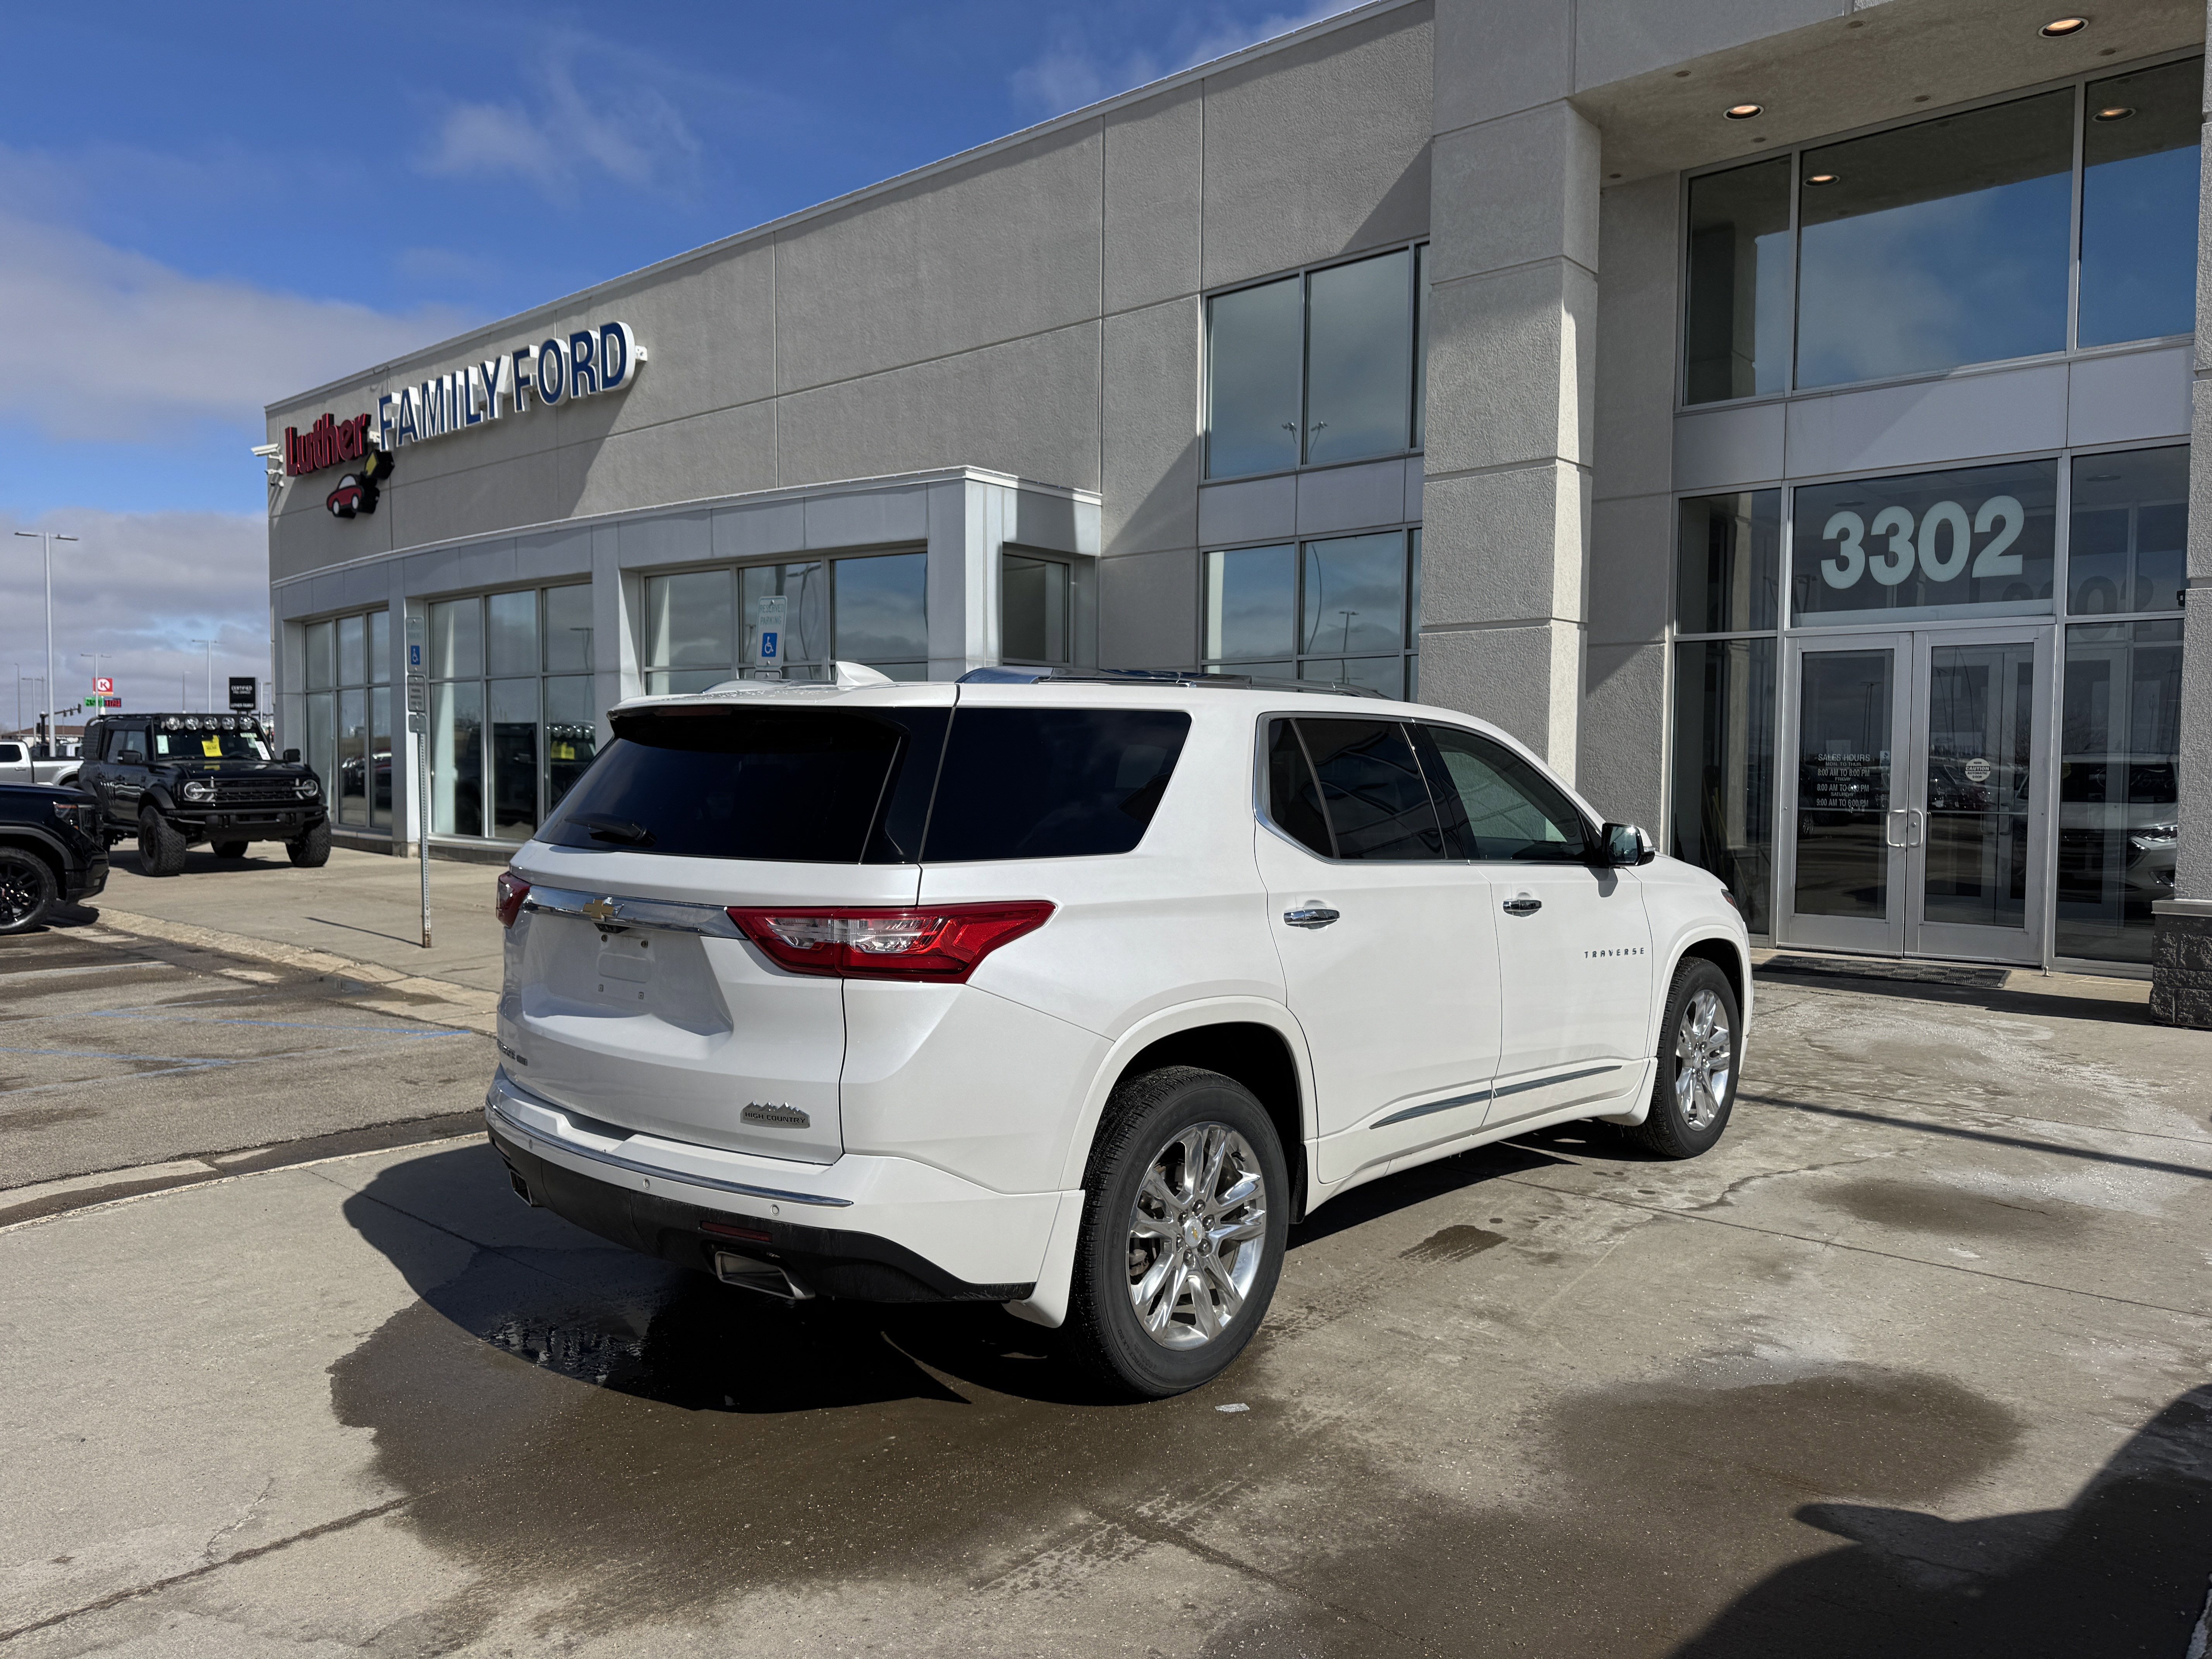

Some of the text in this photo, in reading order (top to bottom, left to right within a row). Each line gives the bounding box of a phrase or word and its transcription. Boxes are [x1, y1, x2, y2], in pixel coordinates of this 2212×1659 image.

[285, 321, 635, 476] Luther FAMILY FORD
[1821, 495, 2024, 589] 3302
[759, 604, 784, 613] RESERVED
[761, 616, 781, 625] PARKING
[100, 682, 108, 690] K
[1584, 947, 1644, 958] TRAVERSE
[766, 1115, 805, 1123] COUNTRY
[1128, 1350, 1170, 1383] CROSSCONTACT
